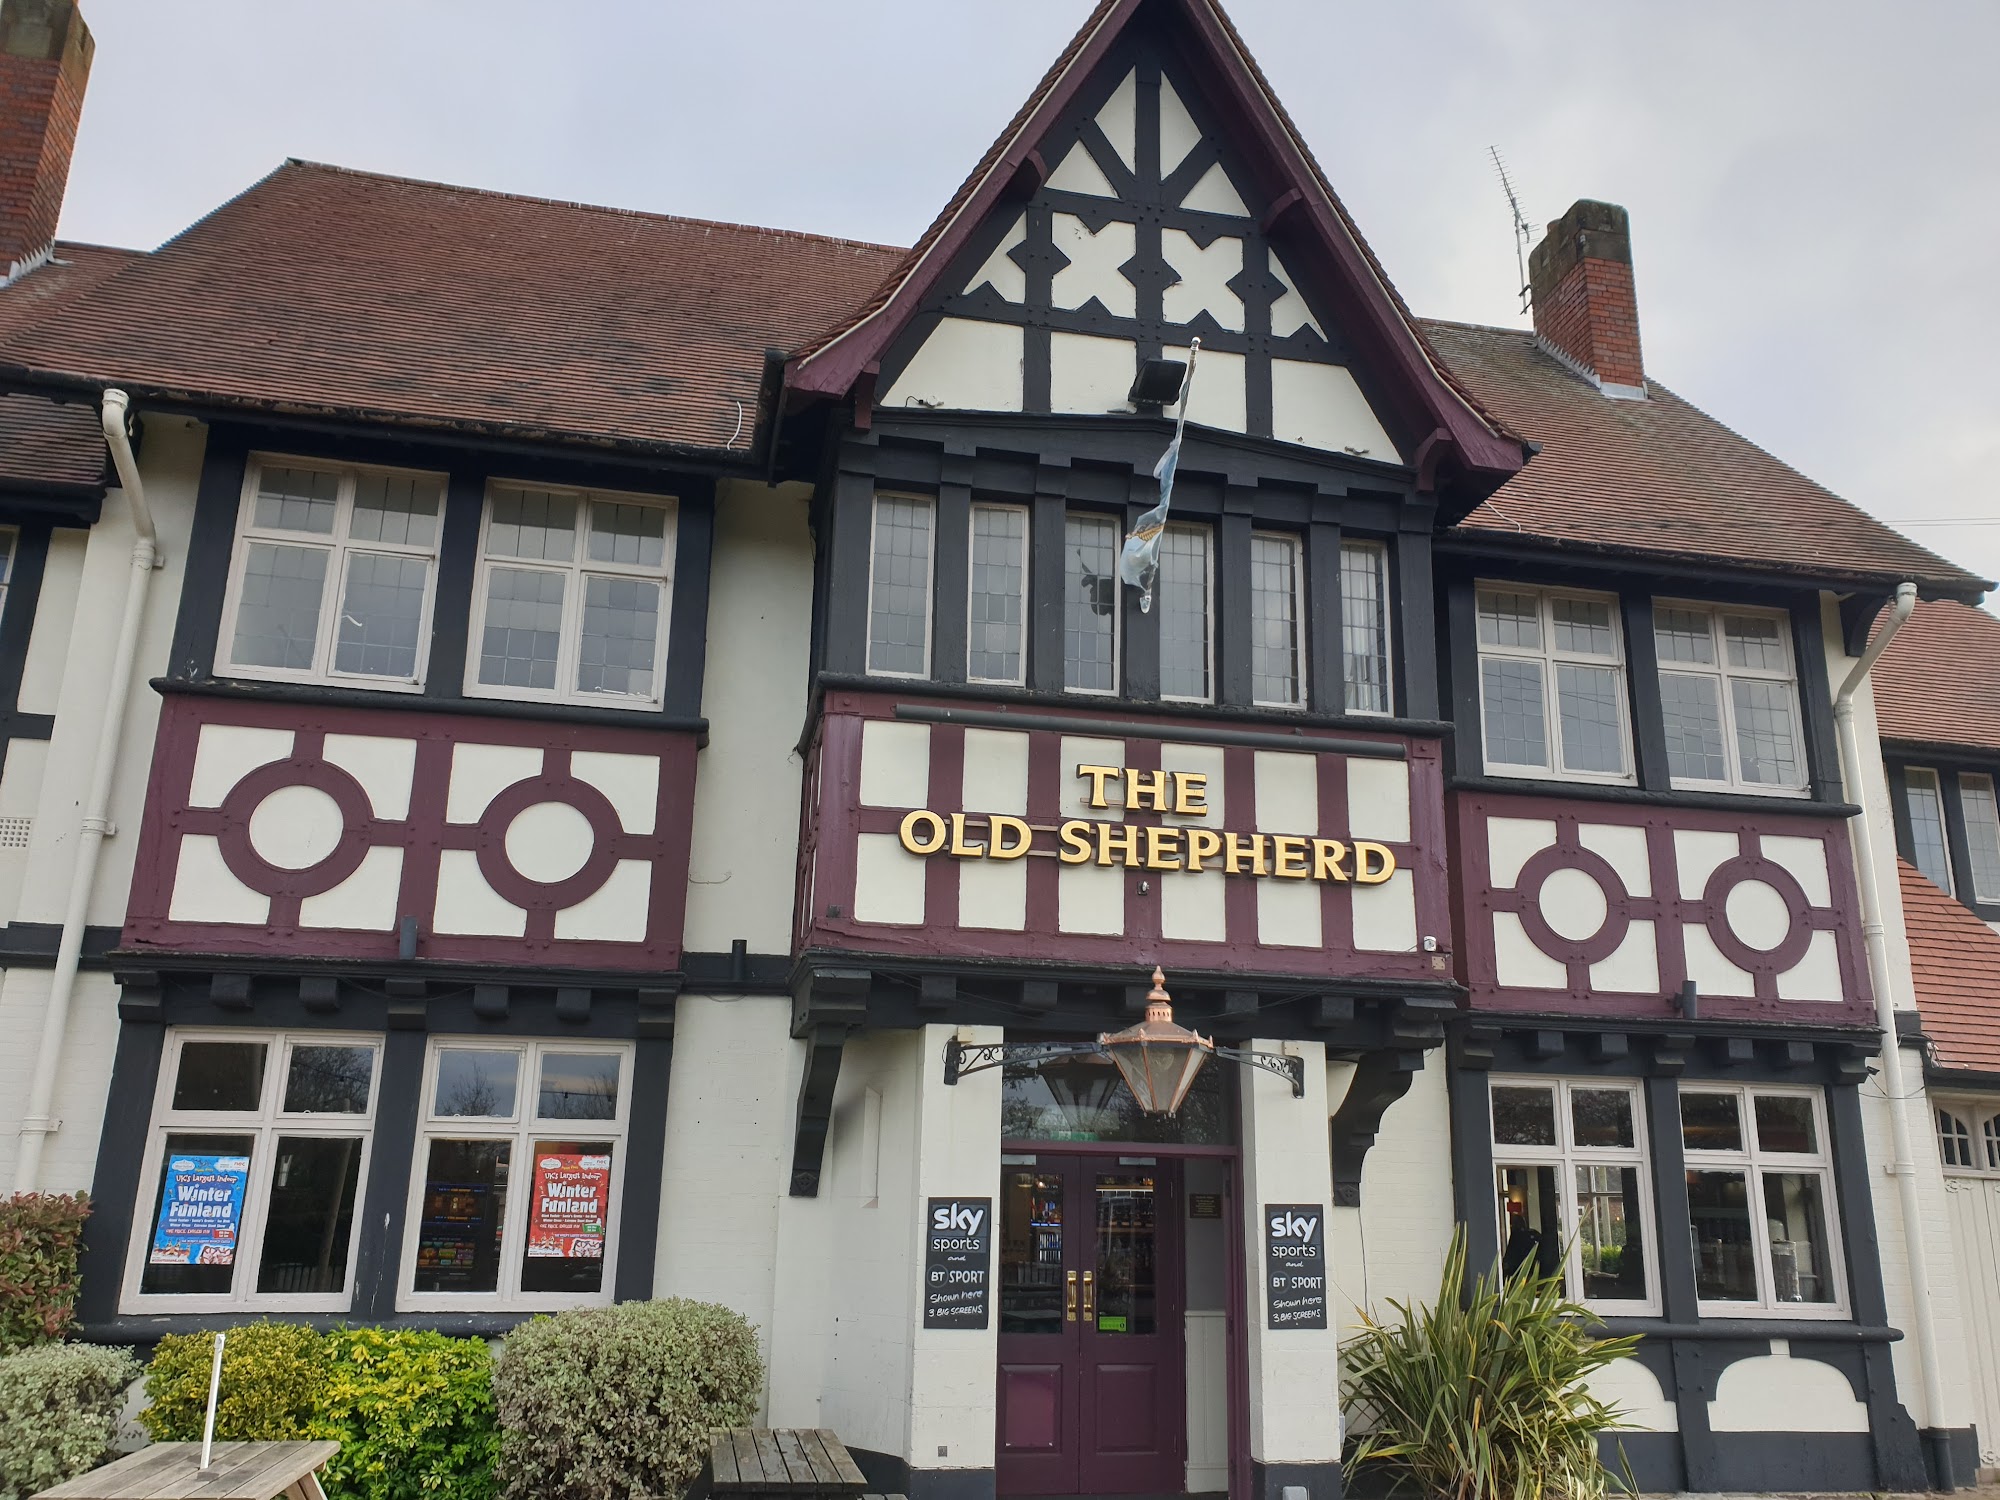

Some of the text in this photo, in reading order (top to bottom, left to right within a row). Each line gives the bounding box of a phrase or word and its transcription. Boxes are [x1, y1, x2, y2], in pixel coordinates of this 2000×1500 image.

[1077, 763, 1208, 816] THE
[899, 809, 1396, 885] OLD SHEPHERD
[192, 1174, 215, 1184] Largest
[217, 1174, 239, 1184] Indoor
[560, 1172, 581, 1181] Largest
[582, 1172, 602, 1181] Indoor
[178, 1183, 231, 1202] Winter
[547, 1181, 597, 1198] Winter
[169, 1202, 232, 1218] Funland
[541, 1198, 598, 1213] Funland
[933, 1203, 983, 1236] sky
[1271, 1211, 1318, 1243] sky
[933, 1238, 980, 1252] sports
[1272, 1244, 1316, 1258] sports
[931, 1271, 984, 1283] BT SPORT
[1273, 1276, 1322, 1288] BT SPORT
[930, 1290, 983, 1303] Shown here
[1273, 1296, 1322, 1309] Shown here
[928, 1304, 983, 1317] 3 BIG SCREENS
[1273, 1309, 1321, 1322] 3 BIG SCREENS
